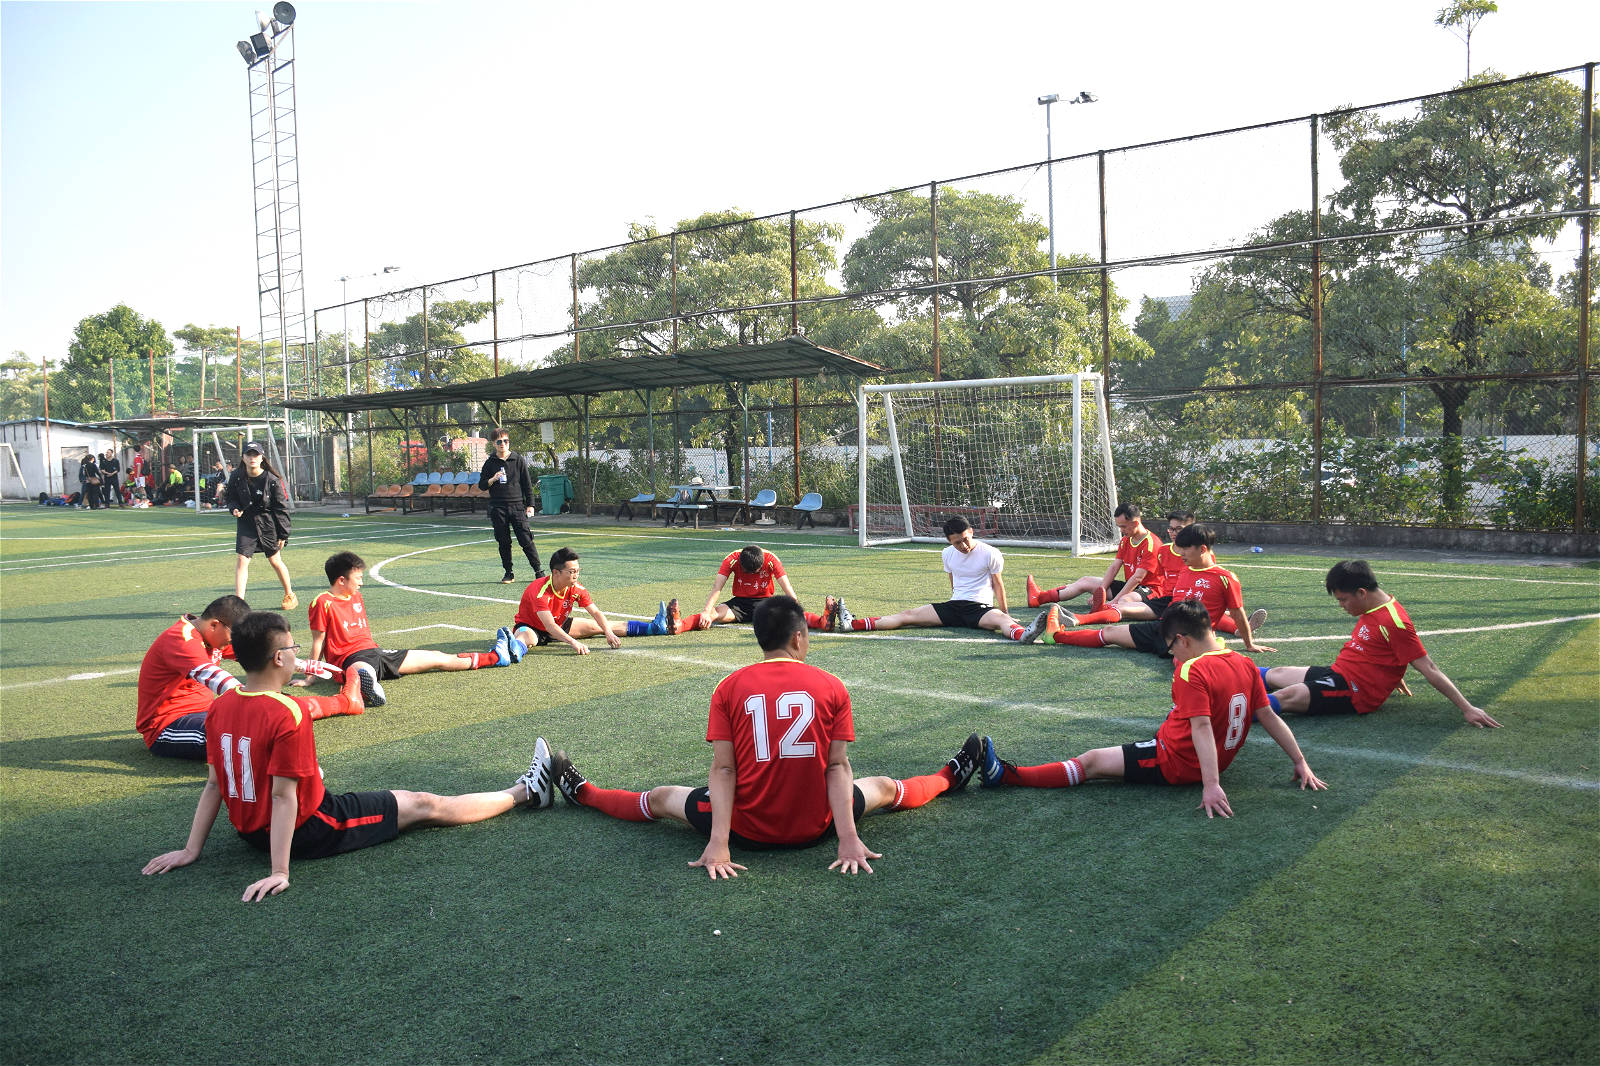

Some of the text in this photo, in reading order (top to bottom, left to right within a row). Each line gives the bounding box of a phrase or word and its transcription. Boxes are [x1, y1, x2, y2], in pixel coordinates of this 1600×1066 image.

[744, 690, 816, 763] 12
[1224, 692, 1248, 750] 8
[220, 732, 257, 803] 11
